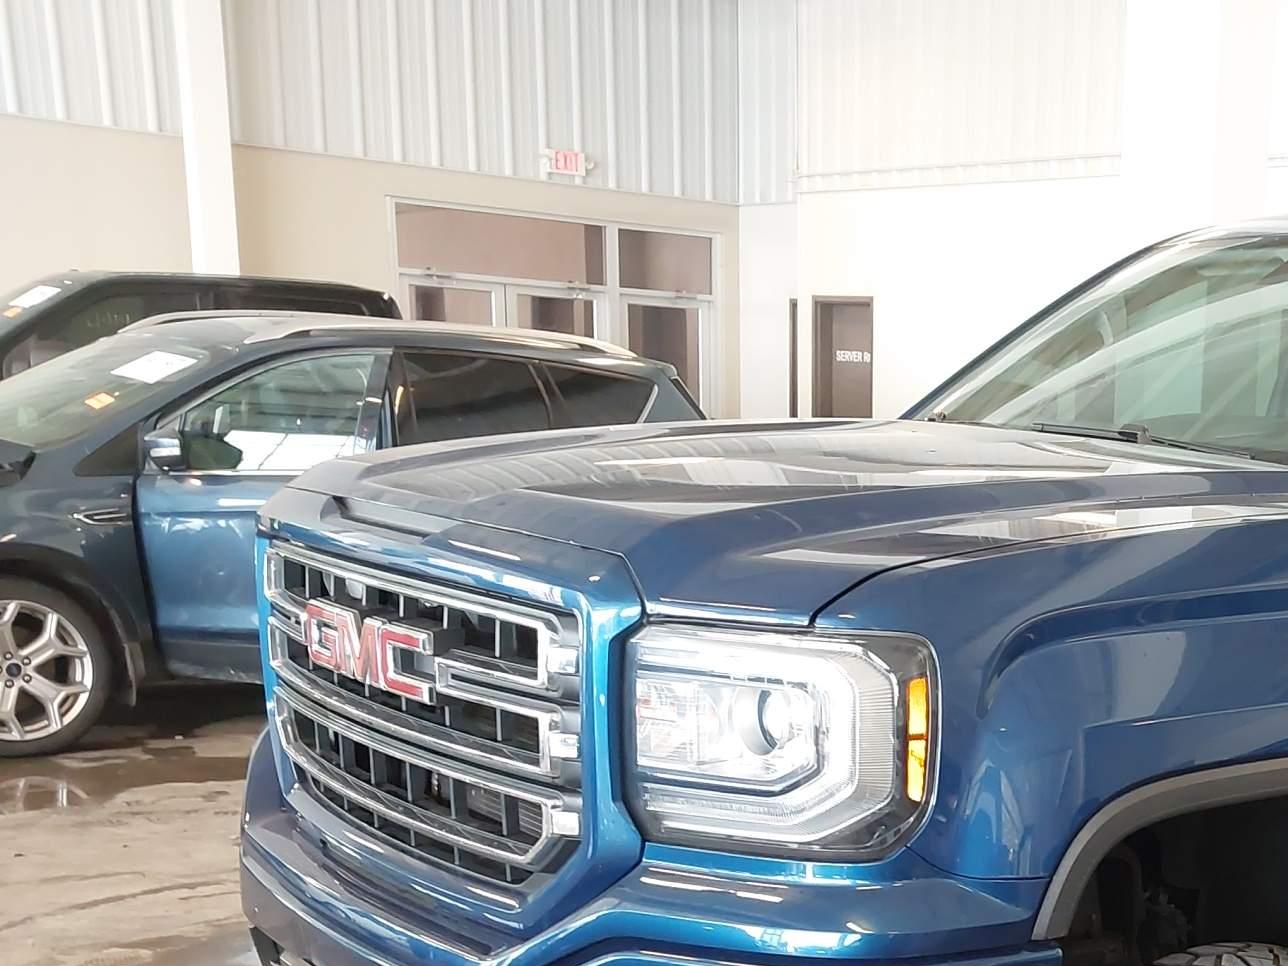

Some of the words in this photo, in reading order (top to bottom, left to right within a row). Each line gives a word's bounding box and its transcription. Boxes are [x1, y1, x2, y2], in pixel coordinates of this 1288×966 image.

[554, 151, 580, 172] EXIT
[836, 350, 863, 362] SERVER
[305, 598, 436, 706] GMC
